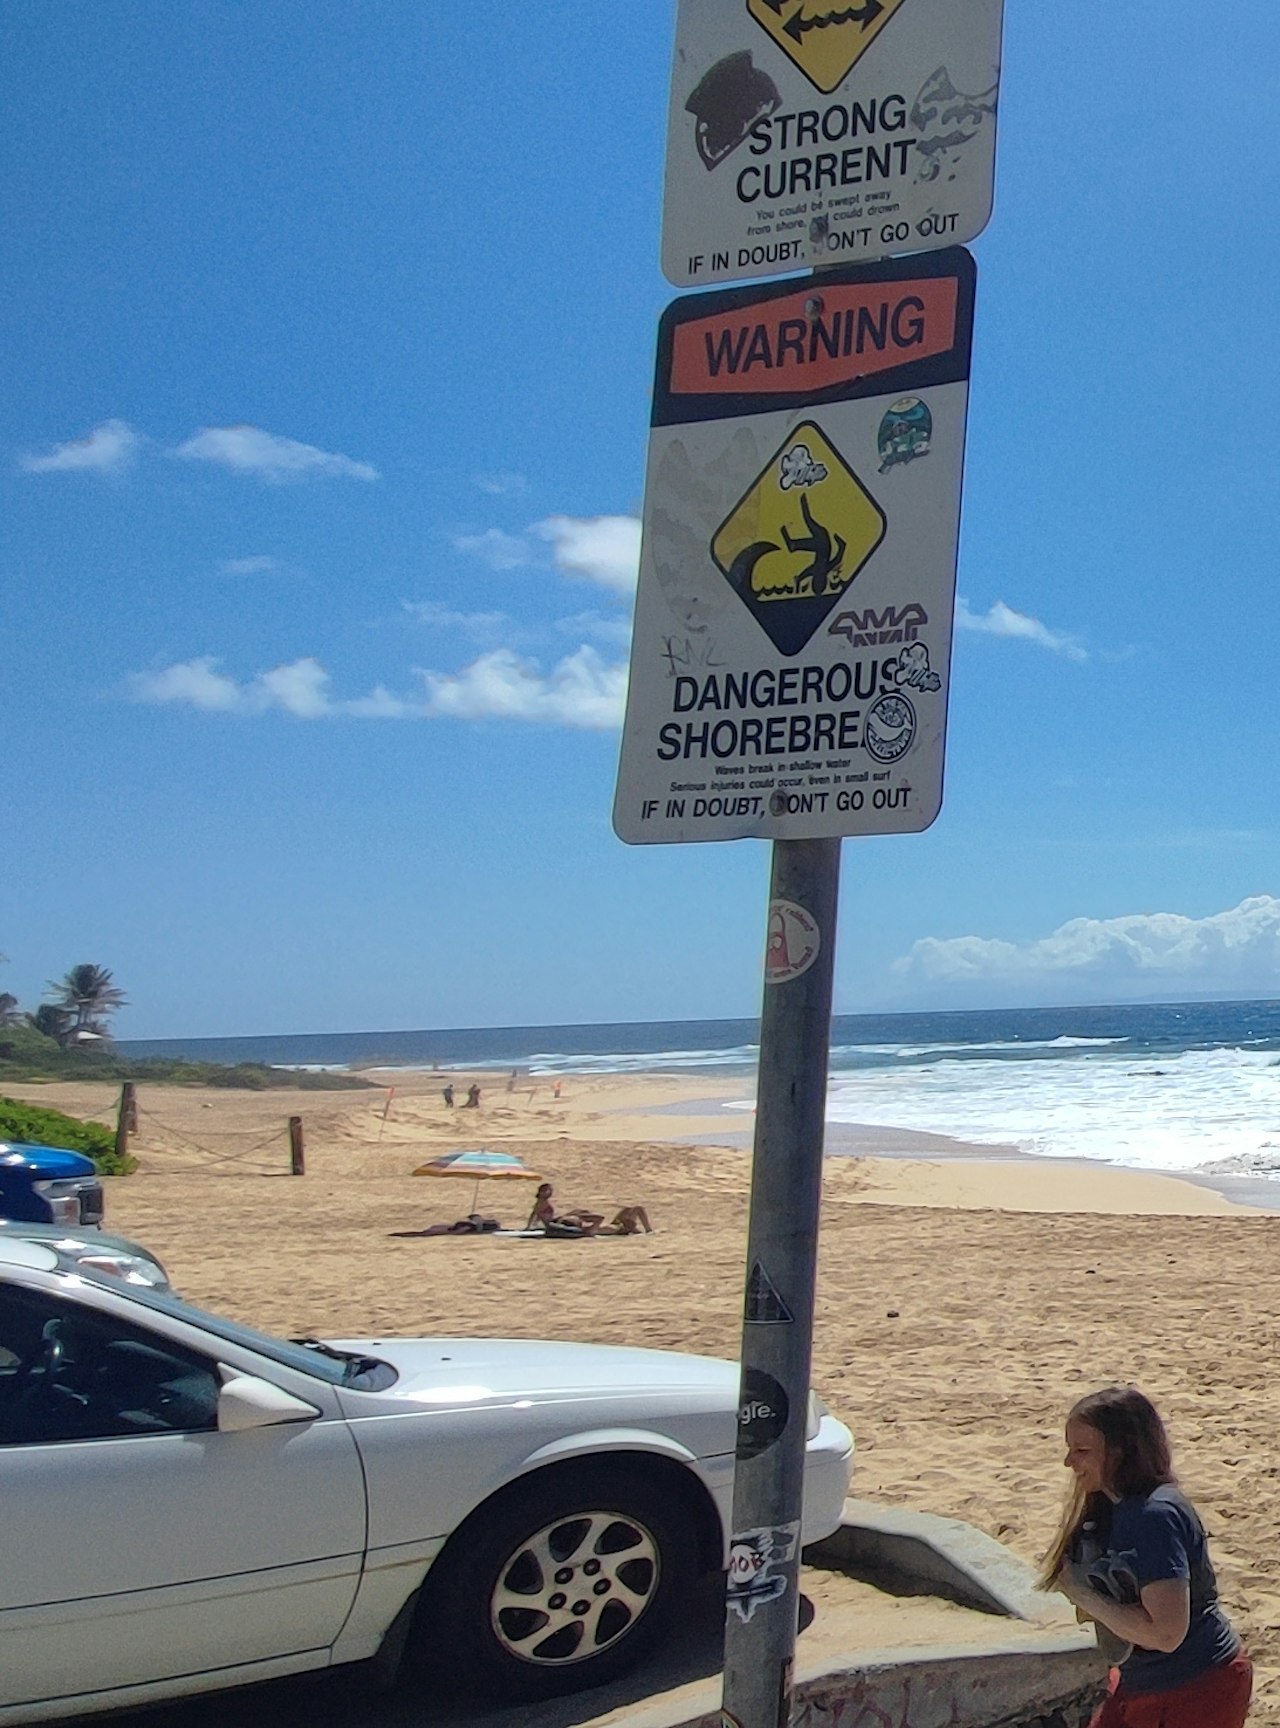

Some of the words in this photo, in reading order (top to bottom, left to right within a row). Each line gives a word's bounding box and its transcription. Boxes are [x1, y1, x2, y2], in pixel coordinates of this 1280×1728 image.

[749, 94, 906, 156] STRONG
[736, 138, 917, 202] CURRENT
[746, 225, 772, 236] from
[833, 207, 863, 221] could
[867, 203, 900, 216] drown
[756, 209, 775, 221] You
[778, 203, 807, 217] could
[811, 200, 824, 212] be
[828, 193, 860, 208] swept
[864, 190, 892, 203] away
[688, 256, 704, 275] IF
[711, 251, 730, 272] IN
[738, 240, 806, 268] DOUBT,
[812, 229, 872, 256] ON'T
[880, 216, 909, 243] GO
[919, 213, 960, 238] OUT
[704, 295, 925, 377] WARNING
[673, 656, 902, 713] DANGEROUS
[657, 710, 866, 761] SHOREBRE
[670, 781, 706, 792] Serious
[710, 780, 745, 792] injuries
[749, 777, 775, 789] could
[808, 774, 830, 785] even
[833, 773, 841, 784] in
[845, 771, 869, 783] small
[872, 769, 891, 781] surf
[714, 765, 745, 775] Waves
[748, 763, 774, 774] break
[777, 762, 786, 772] in
[789, 760, 823, 771] shallow
[825, 758, 851, 769] water
[641, 799, 659, 820] IF
[666, 799, 686, 819] IN
[693, 796, 766, 820] DOUBT,
[772, 792, 830, 815] ON'T
[836, 790, 865, 811] GO
[872, 787, 912, 809] OUT
